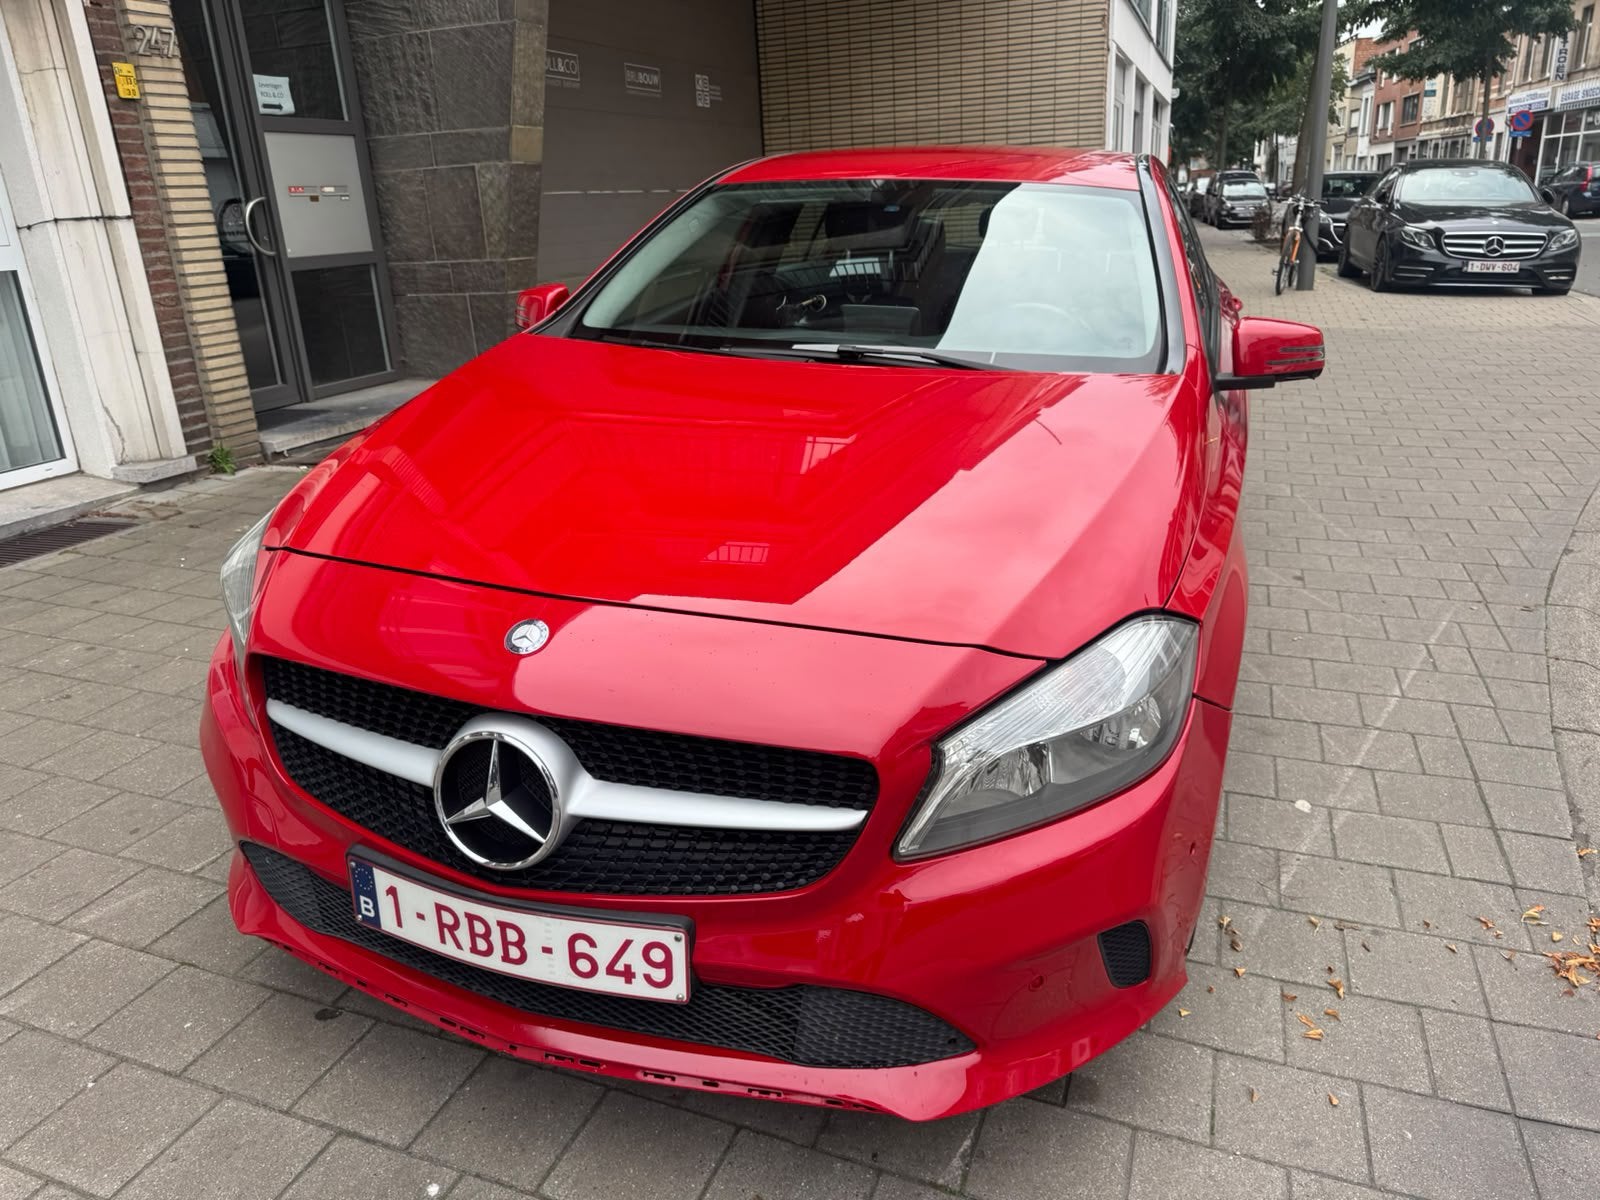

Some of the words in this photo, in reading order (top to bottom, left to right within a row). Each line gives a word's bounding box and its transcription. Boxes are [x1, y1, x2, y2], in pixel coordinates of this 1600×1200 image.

[133, 25, 175, 58] 247
[359, 896, 375, 917] B
[385, 885, 674, 989] 1-RBB-649
